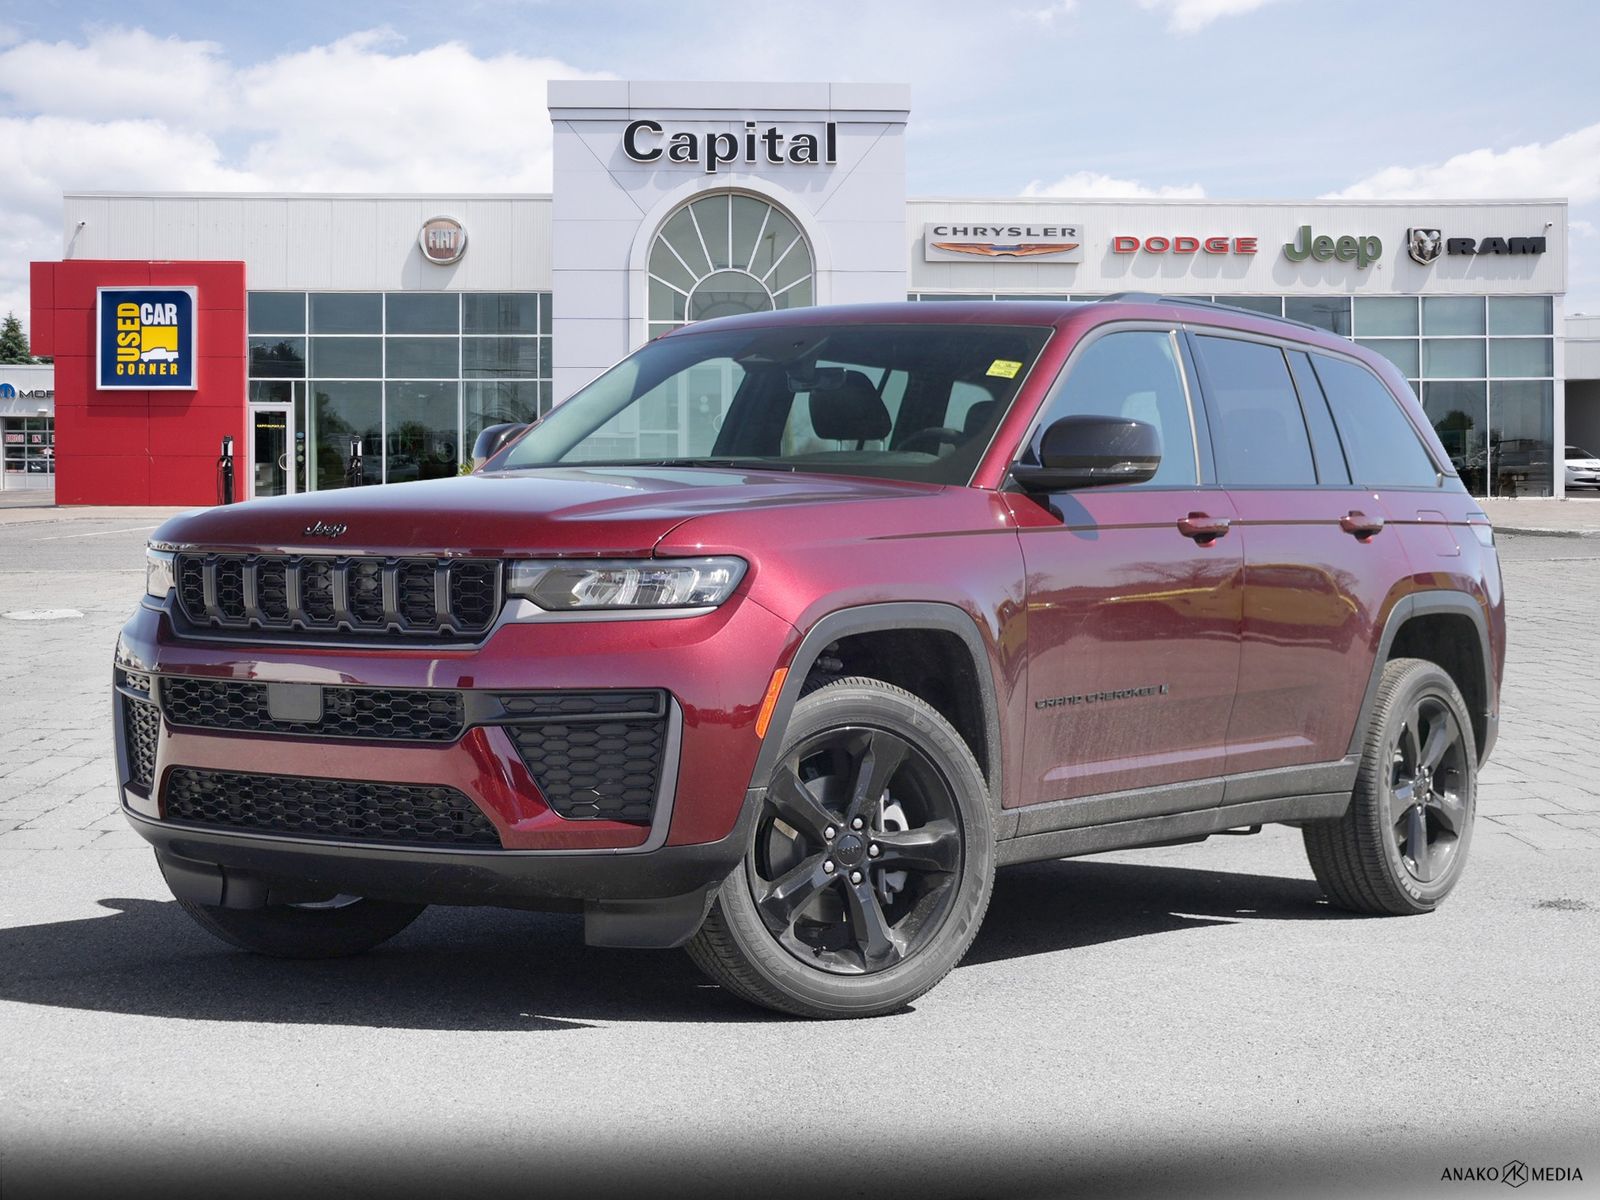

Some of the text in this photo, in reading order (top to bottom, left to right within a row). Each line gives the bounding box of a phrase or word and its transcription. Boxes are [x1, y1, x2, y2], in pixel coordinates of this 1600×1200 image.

[623, 119, 837, 174] Capital
[933, 226, 1076, 237] CHRYSLER
[1113, 236, 1258, 254] DODGE
[1282, 225, 1383, 270] Jeep
[1447, 236, 1546, 255] RAM
[140, 303, 178, 325] CAR
[117, 303, 140, 362] USED
[116, 363, 178, 375] CORNER
[303, 520, 348, 538] Jeep
[1035, 694, 1083, 710] GRAND
[1085, 685, 1156, 704] CHEROKEE
